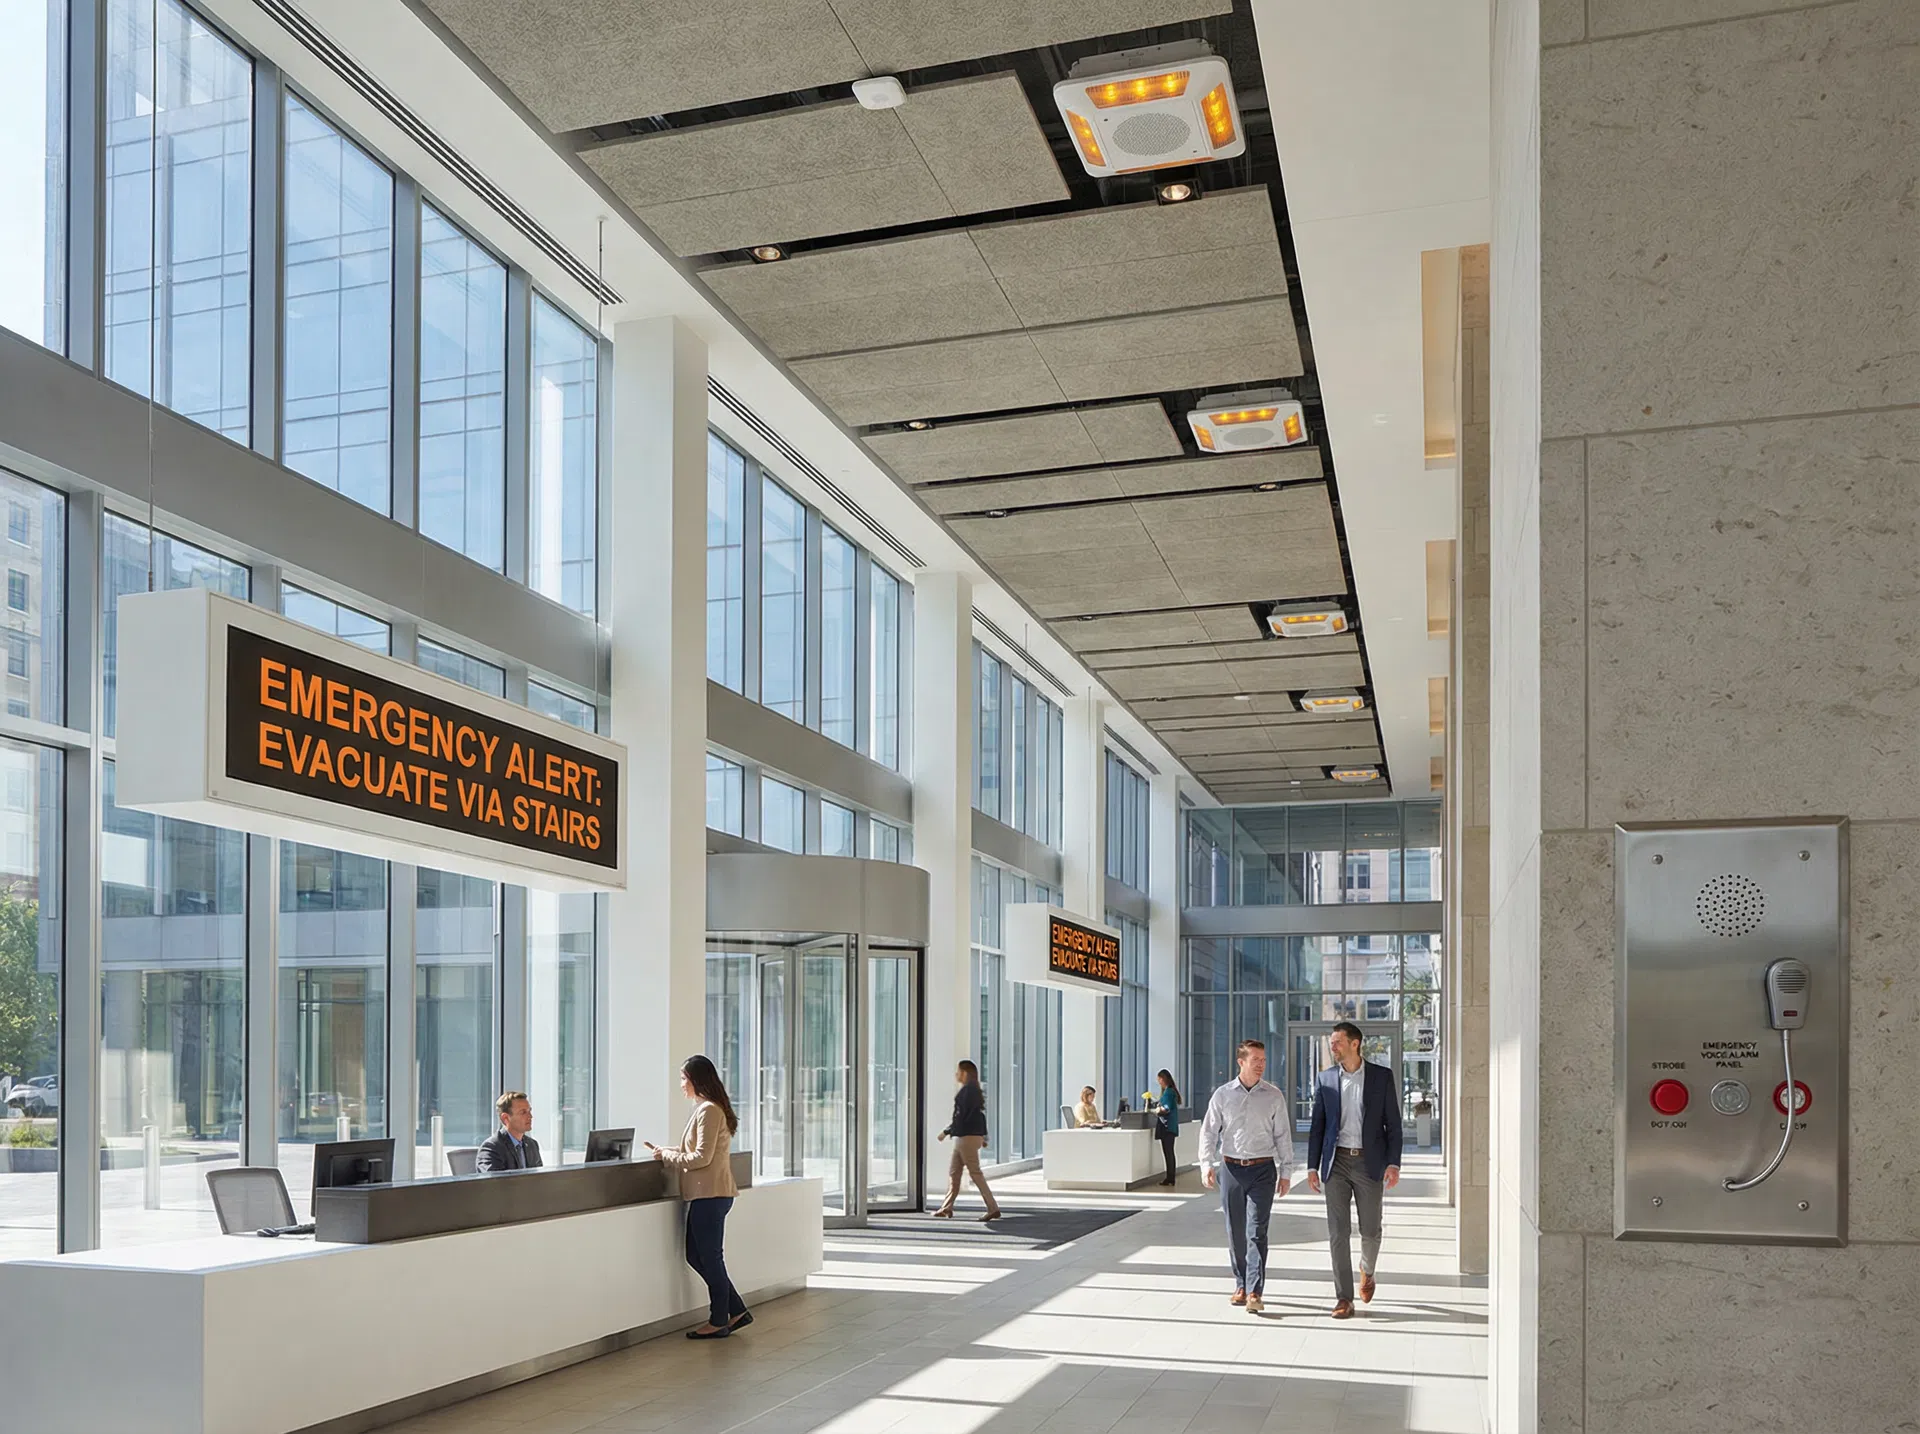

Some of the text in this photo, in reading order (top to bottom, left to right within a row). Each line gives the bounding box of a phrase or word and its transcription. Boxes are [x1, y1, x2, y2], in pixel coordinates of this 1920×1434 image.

[259, 721, 602, 850] EVACUATE VIA STAIRS
[260, 658, 604, 807] EMERGENCY ALERT:
[1702, 1042, 1758, 1050] EMERGENCY
